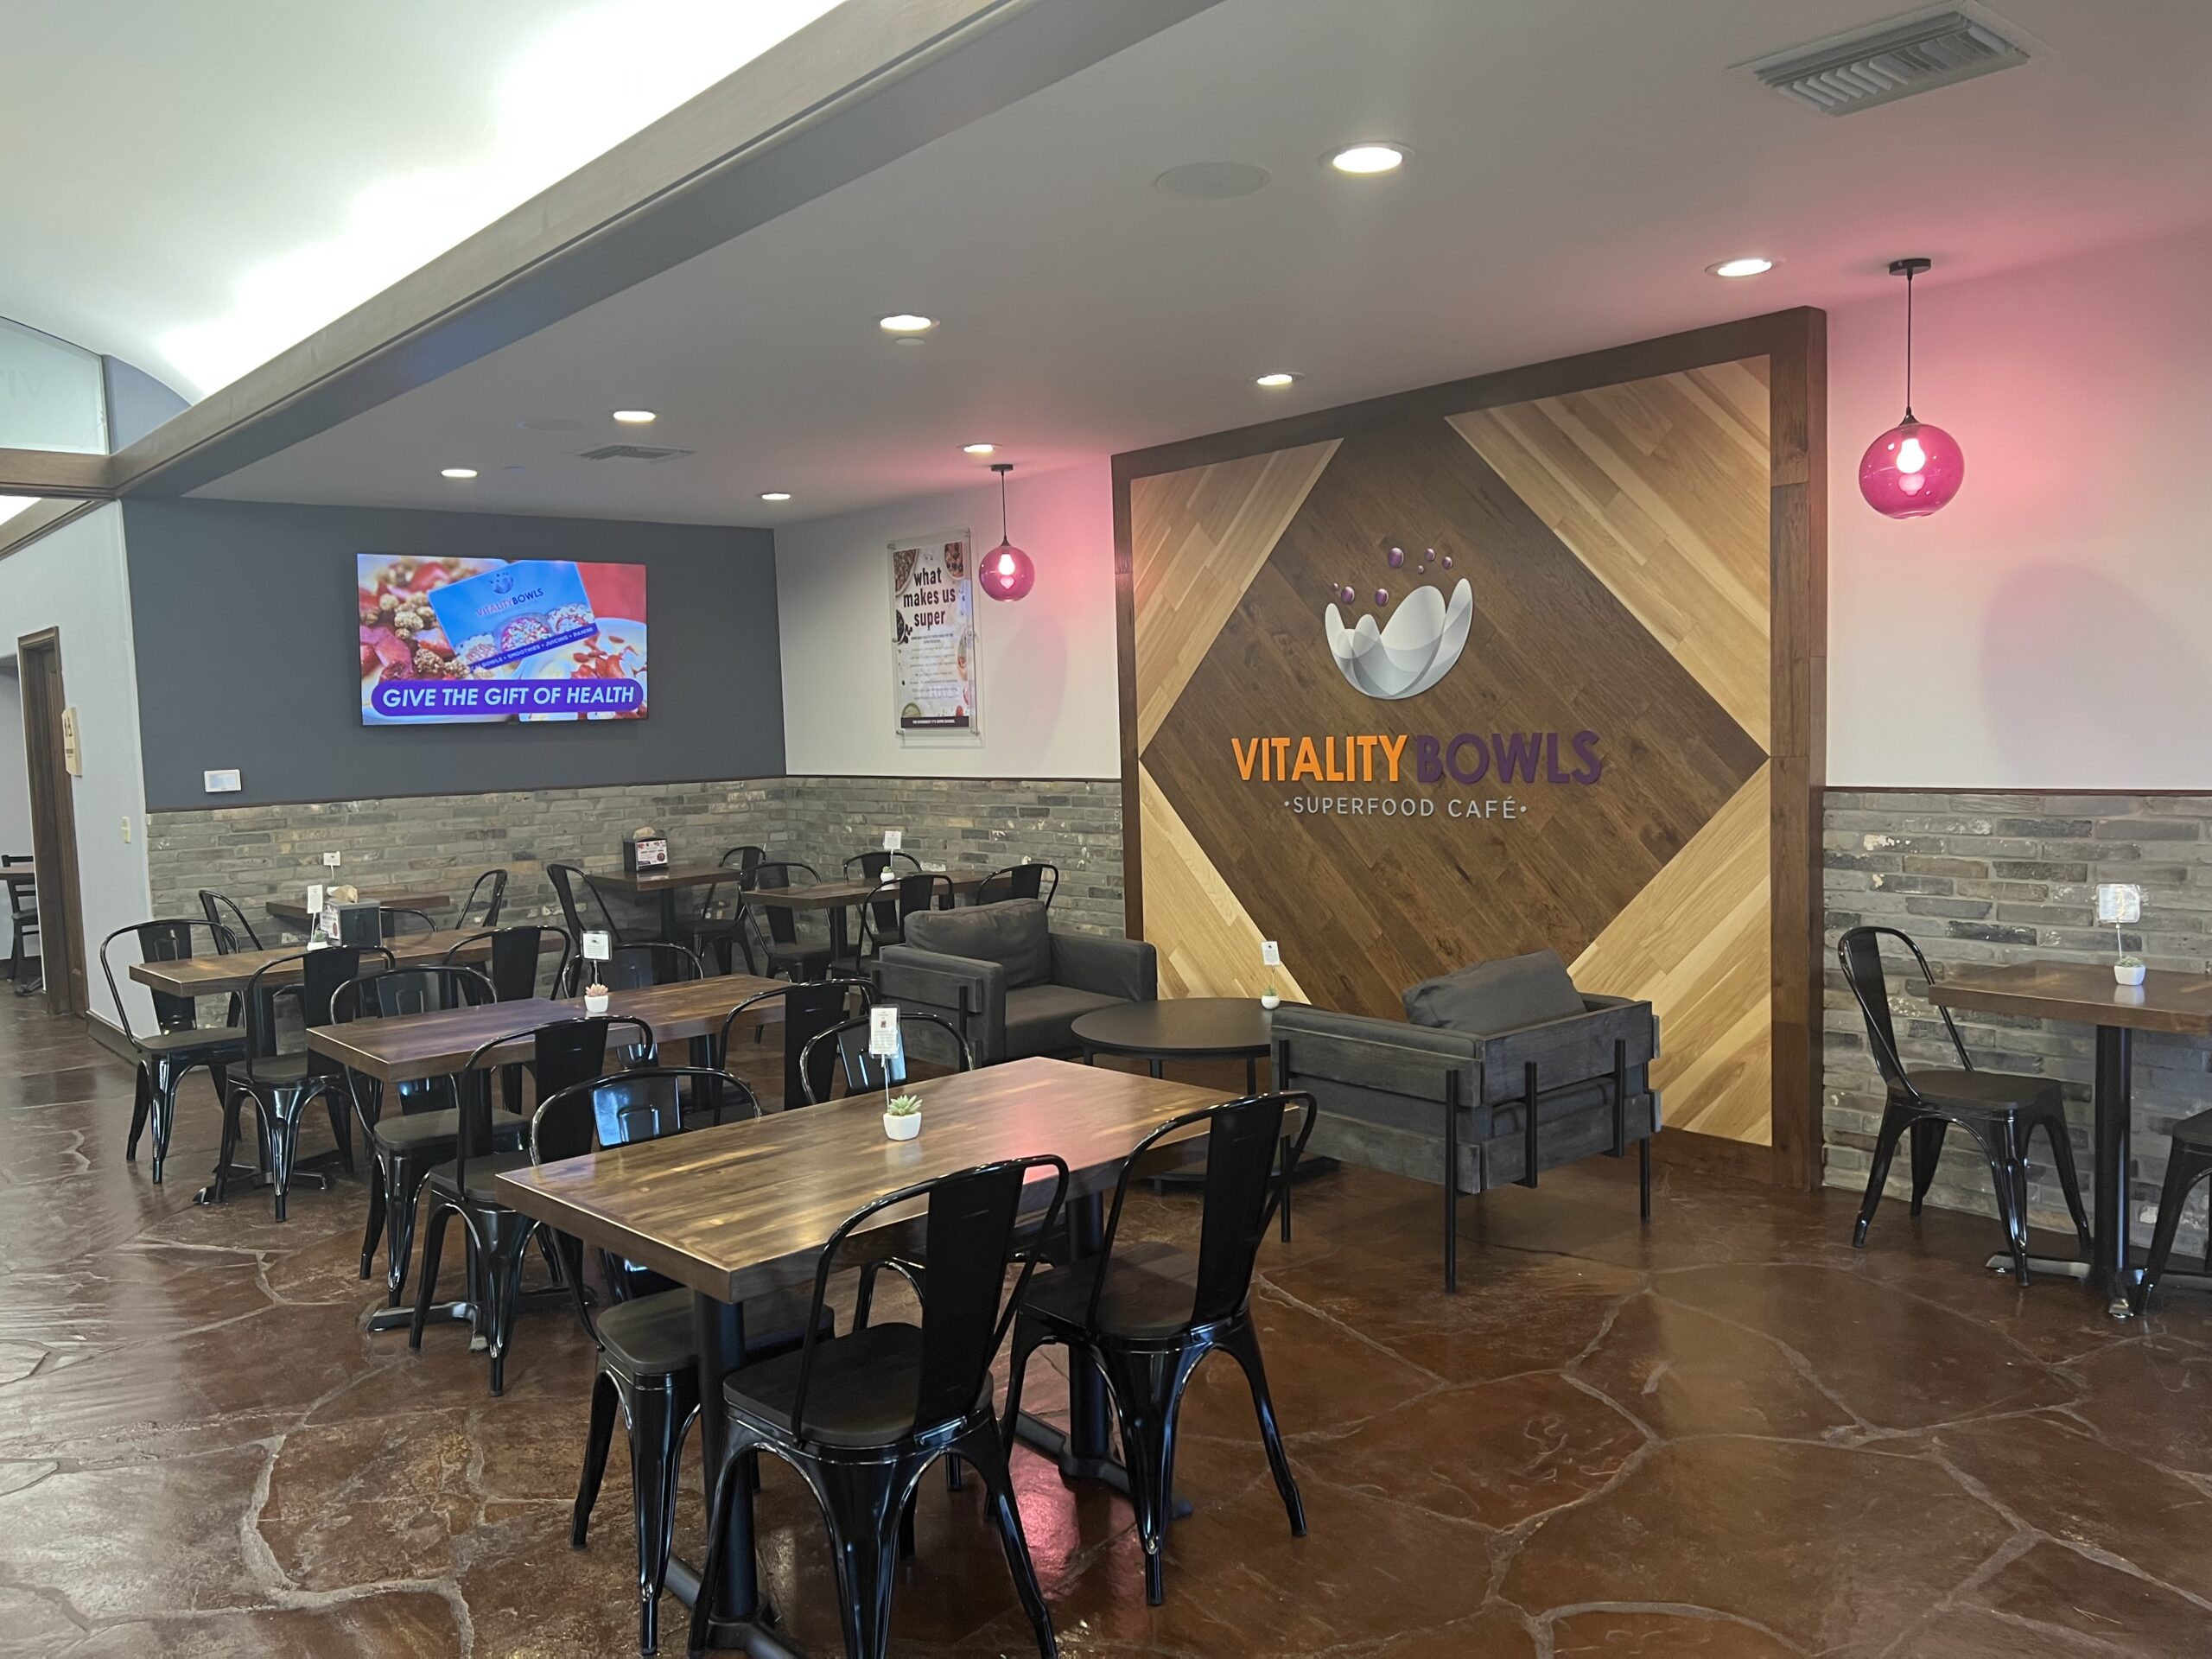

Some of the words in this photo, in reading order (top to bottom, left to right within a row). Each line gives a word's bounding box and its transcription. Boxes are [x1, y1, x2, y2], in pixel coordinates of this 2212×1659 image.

[914, 567, 942, 587] what
[476, 598, 512, 616] VITALITY
[512, 588, 543, 605] BOWLS
[903, 587, 939, 608] makes
[943, 588, 957, 603] us
[914, 609, 946, 630] super
[507, 645, 541, 659] SMOOTHIES
[545, 635, 569, 646] JUICING
[382, 688, 435, 708] GIVE
[442, 688, 478, 707] THE
[485, 687, 529, 706] GIFT
[533, 686, 561, 705] OF
[566, 685, 634, 704] HEALTH
[1231, 734, 1408, 782] VITALITY
[1415, 730, 1603, 786] BOWLS
[1293, 796, 1435, 817] SUPERFOOD
[1447, 795, 1517, 819] CAFÉ
